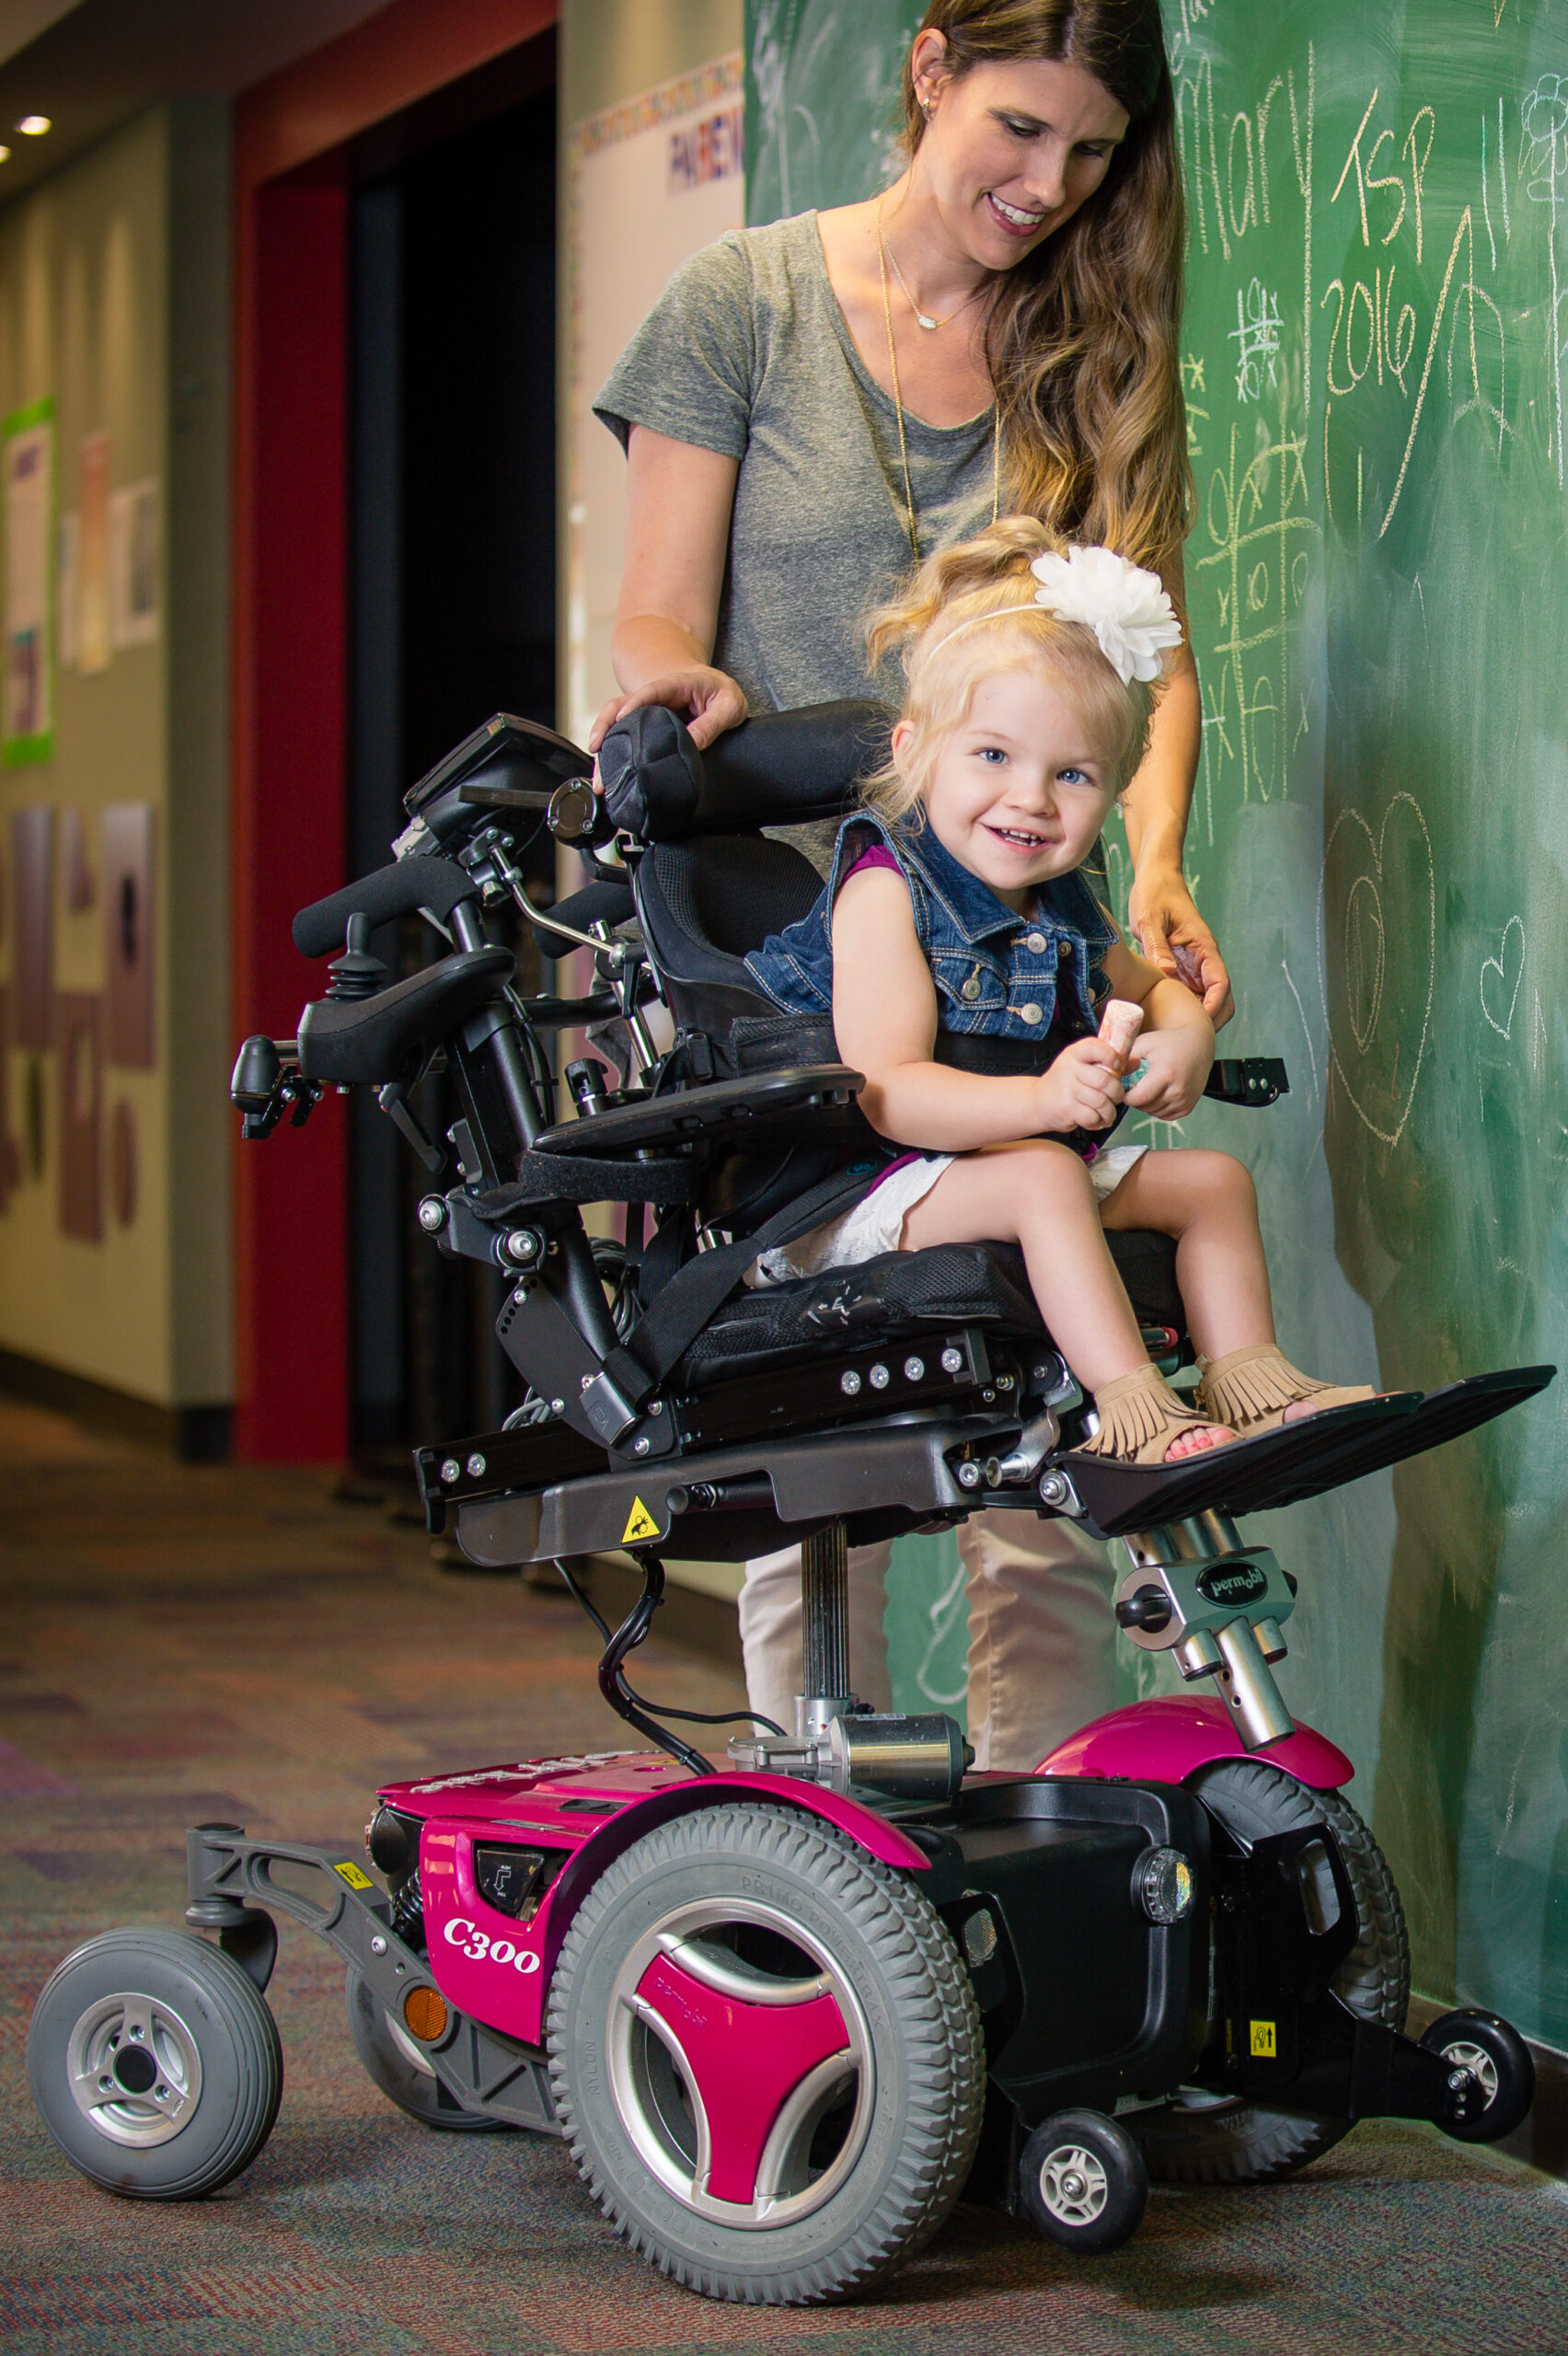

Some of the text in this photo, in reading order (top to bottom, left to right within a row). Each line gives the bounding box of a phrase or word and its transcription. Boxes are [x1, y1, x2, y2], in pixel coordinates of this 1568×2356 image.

[1321, 263, 1416, 398] 2016
[1211, 1568, 1264, 1597] permobil
[444, 1918, 540, 1973] C300
